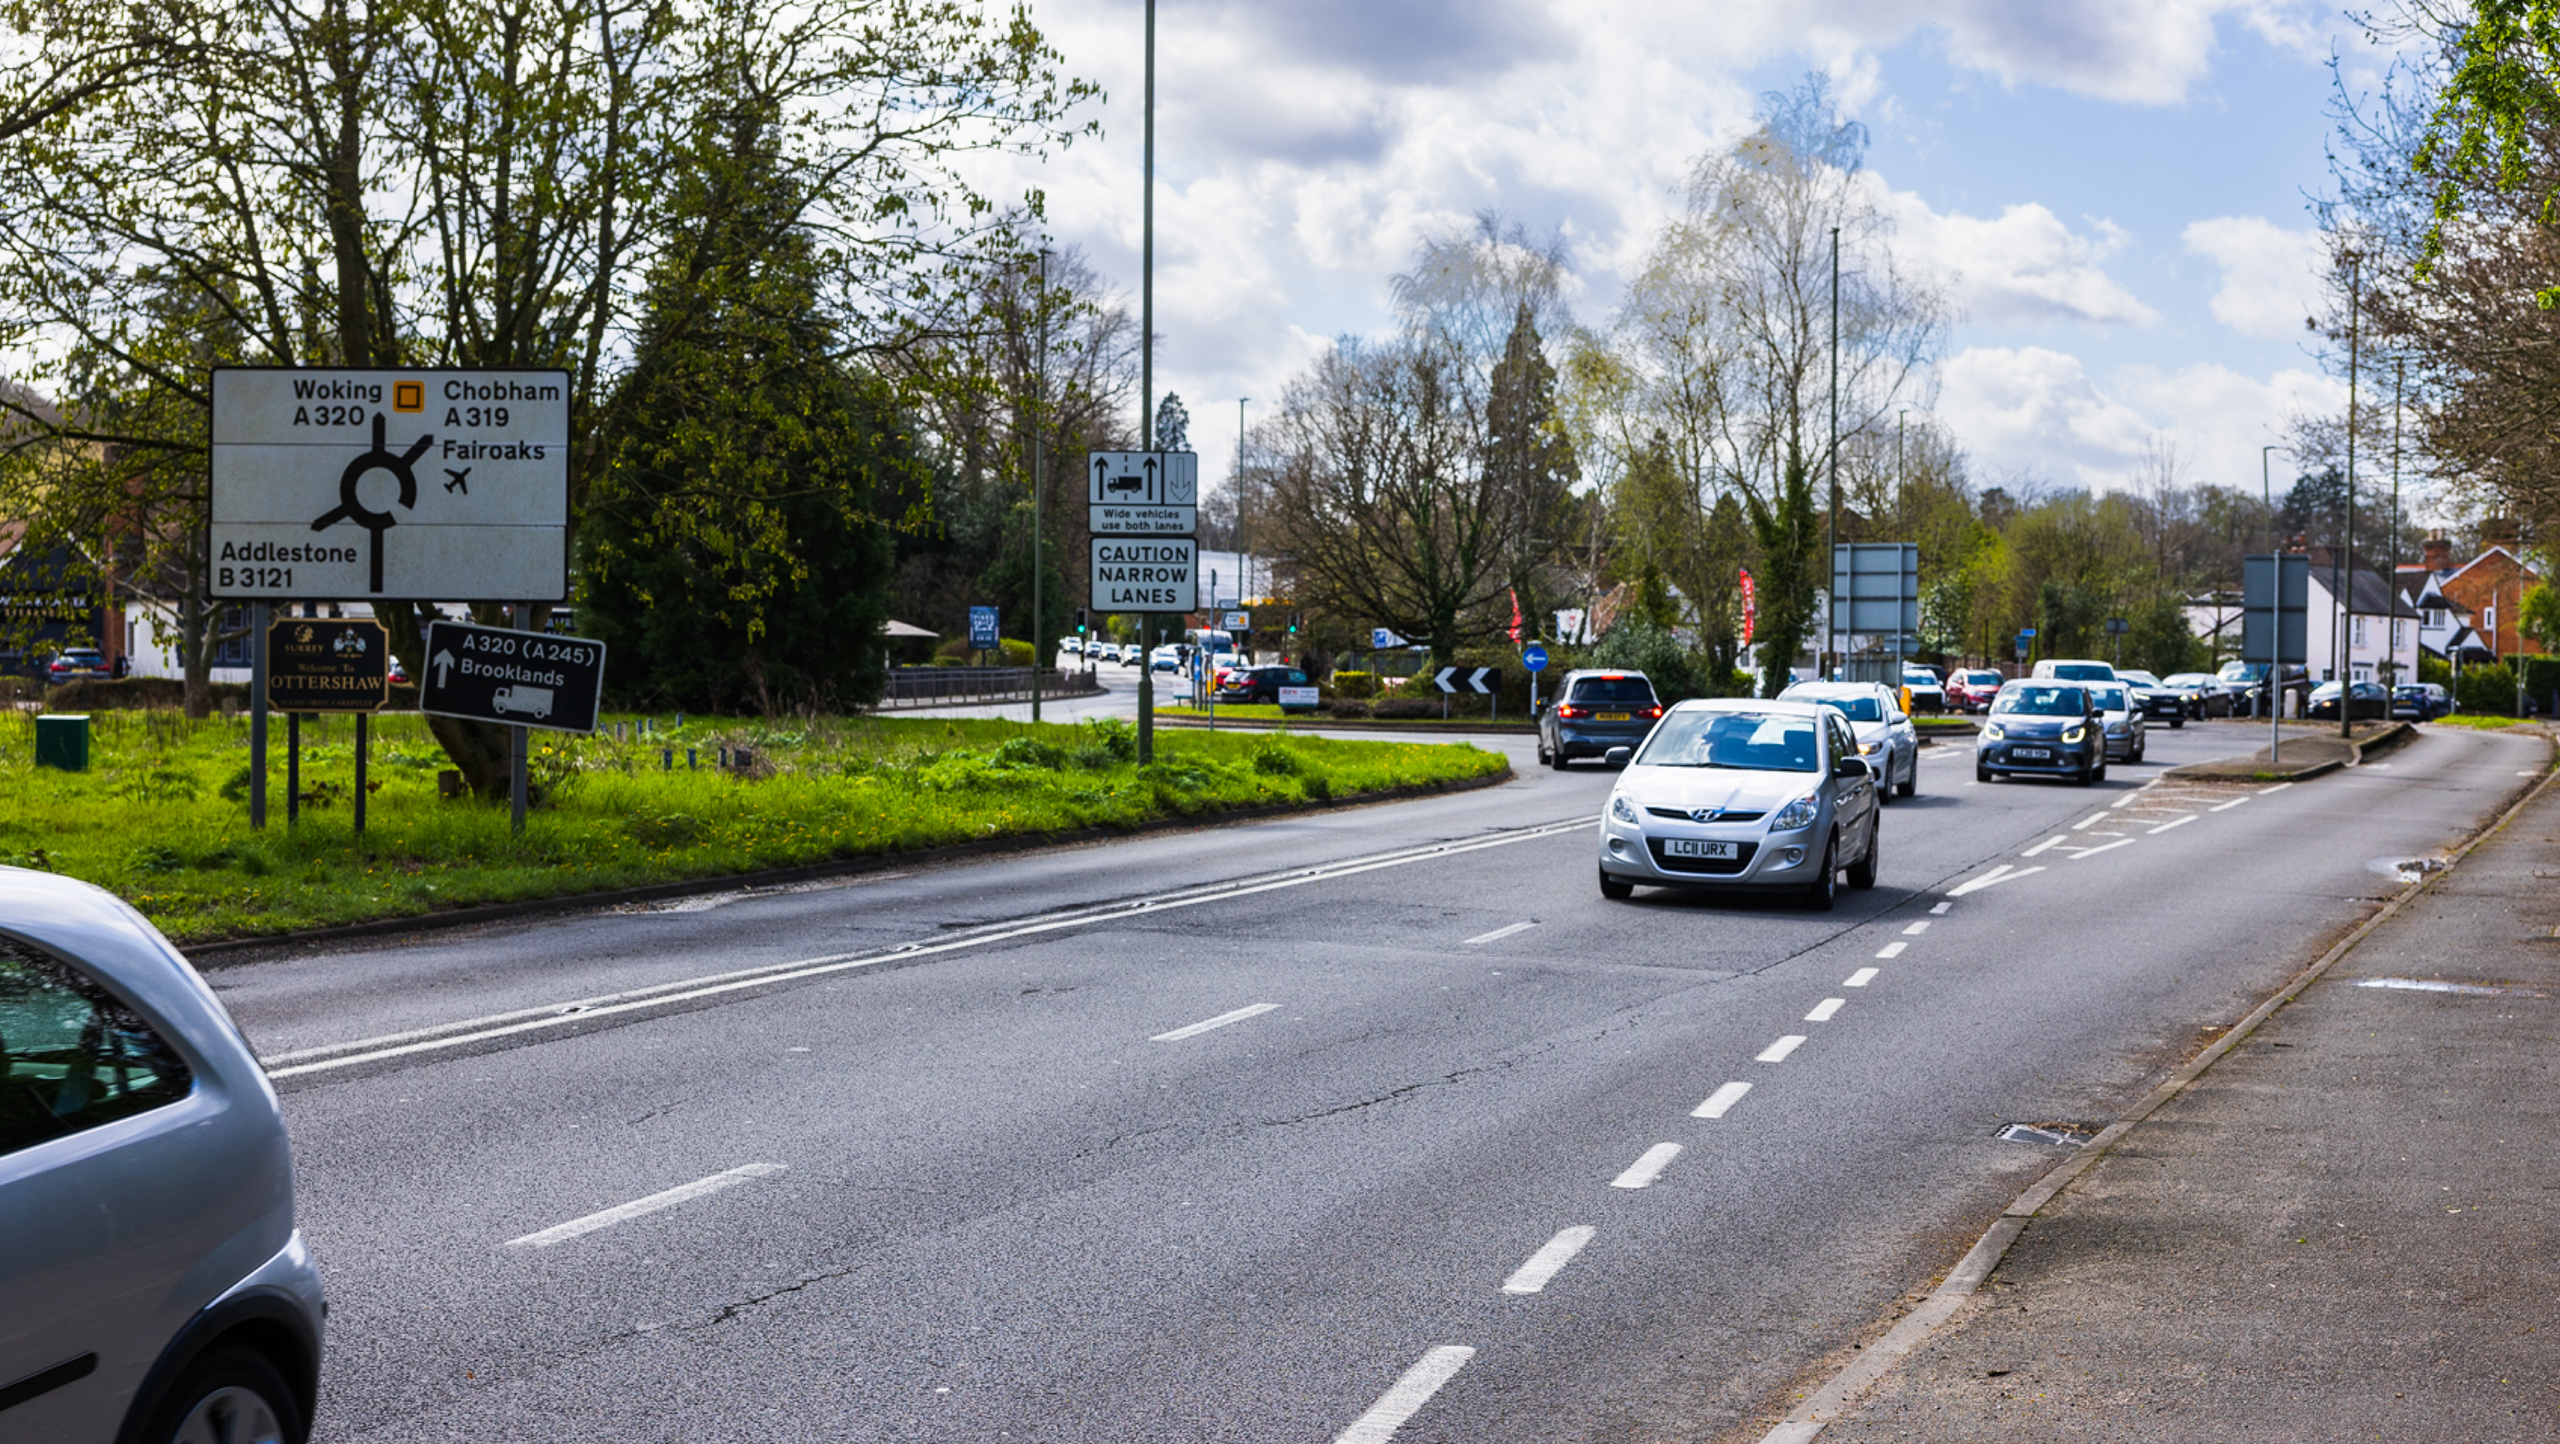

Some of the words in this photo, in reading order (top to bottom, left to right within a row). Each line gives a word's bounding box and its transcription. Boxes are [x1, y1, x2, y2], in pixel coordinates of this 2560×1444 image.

[293, 380, 382, 403] Woking
[444, 380, 560, 401] Chobham
[443, 440, 545, 460] Fairoaks
[1103, 509, 1131, 519] Wide
[1135, 509, 1180, 519] vehicles
[1101, 522, 1121, 530] use
[1125, 521, 1150, 531] both
[1155, 521, 1184, 531] lanes
[220, 541, 357, 563] Addlestone
[1098, 546, 1189, 562] CAUTION
[1098, 567, 1188, 583] NARROW
[1111, 588, 1177, 604] LANES
[284, 644, 324, 652] SURREY
[298, 664, 336, 673] Welcome
[343, 664, 355, 673] To
[460, 658, 565, 687] Brooklands
[270, 675, 383, 690] OTTERSHAW
[1674, 841, 1698, 855] LC11
[1701, 842, 1727, 857] URX
